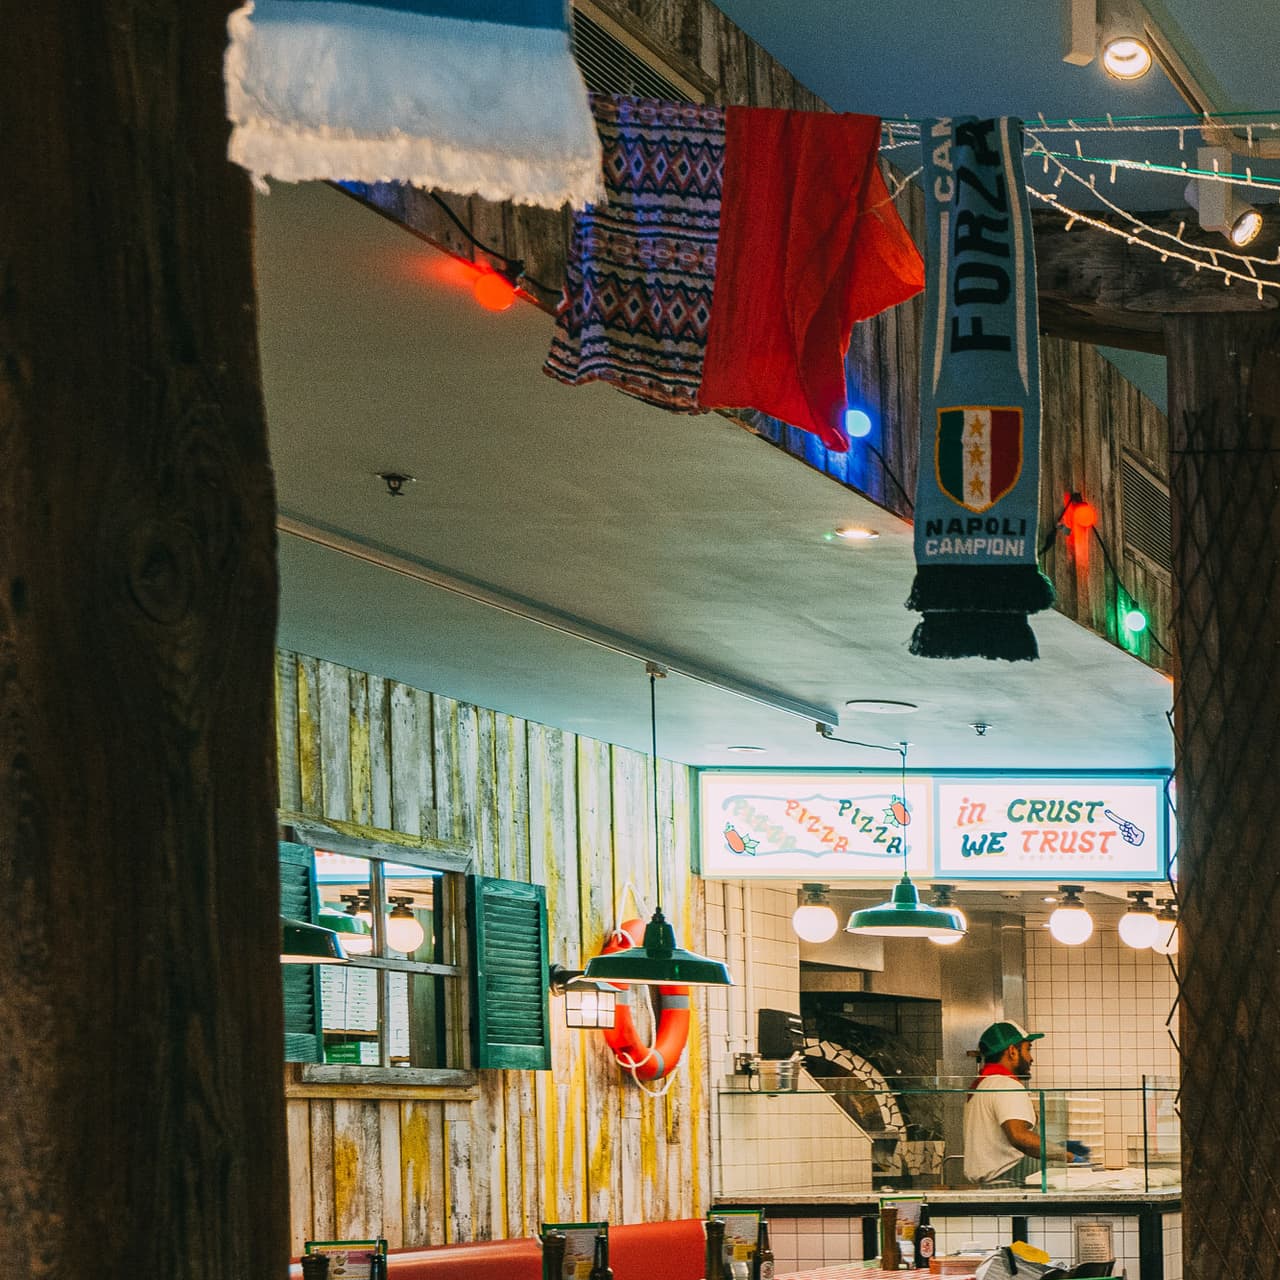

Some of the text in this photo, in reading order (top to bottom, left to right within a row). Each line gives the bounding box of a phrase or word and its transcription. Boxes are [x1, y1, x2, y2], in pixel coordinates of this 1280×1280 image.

[951, 117, 1012, 353] FORZA
[925, 517, 1028, 537] NAPOLI
[925, 537, 1026, 558] CAMPIONI
[1007, 799, 1105, 824] CRUST
[784, 799, 850, 854] PIZZA
[838, 799, 904, 855] PIZZA
[961, 830, 1117, 858] WE TRUST
